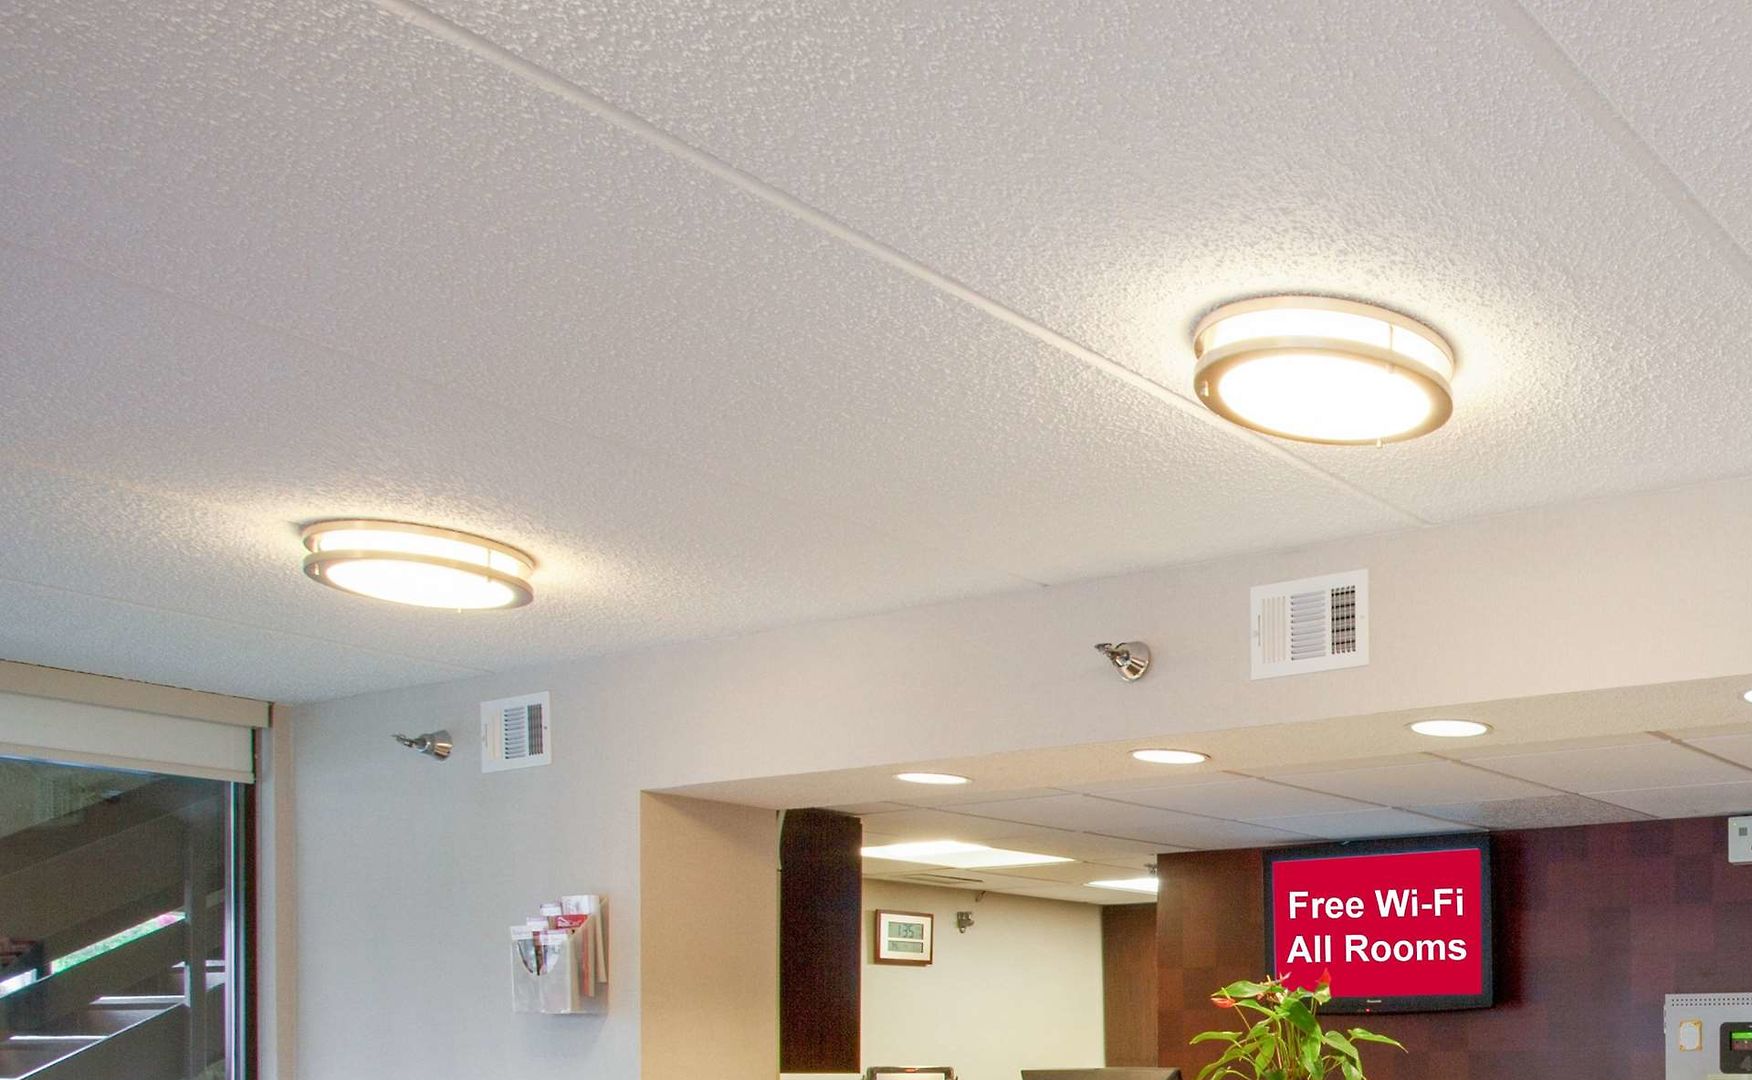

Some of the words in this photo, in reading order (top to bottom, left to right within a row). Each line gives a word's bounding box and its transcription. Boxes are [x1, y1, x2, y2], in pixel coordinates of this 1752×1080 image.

[1288, 890, 1365, 920] Free
[1374, 887, 1464, 918] Wi-Fi
[1286, 934, 1332, 964] All
[1344, 933, 1468, 963] Rooms
